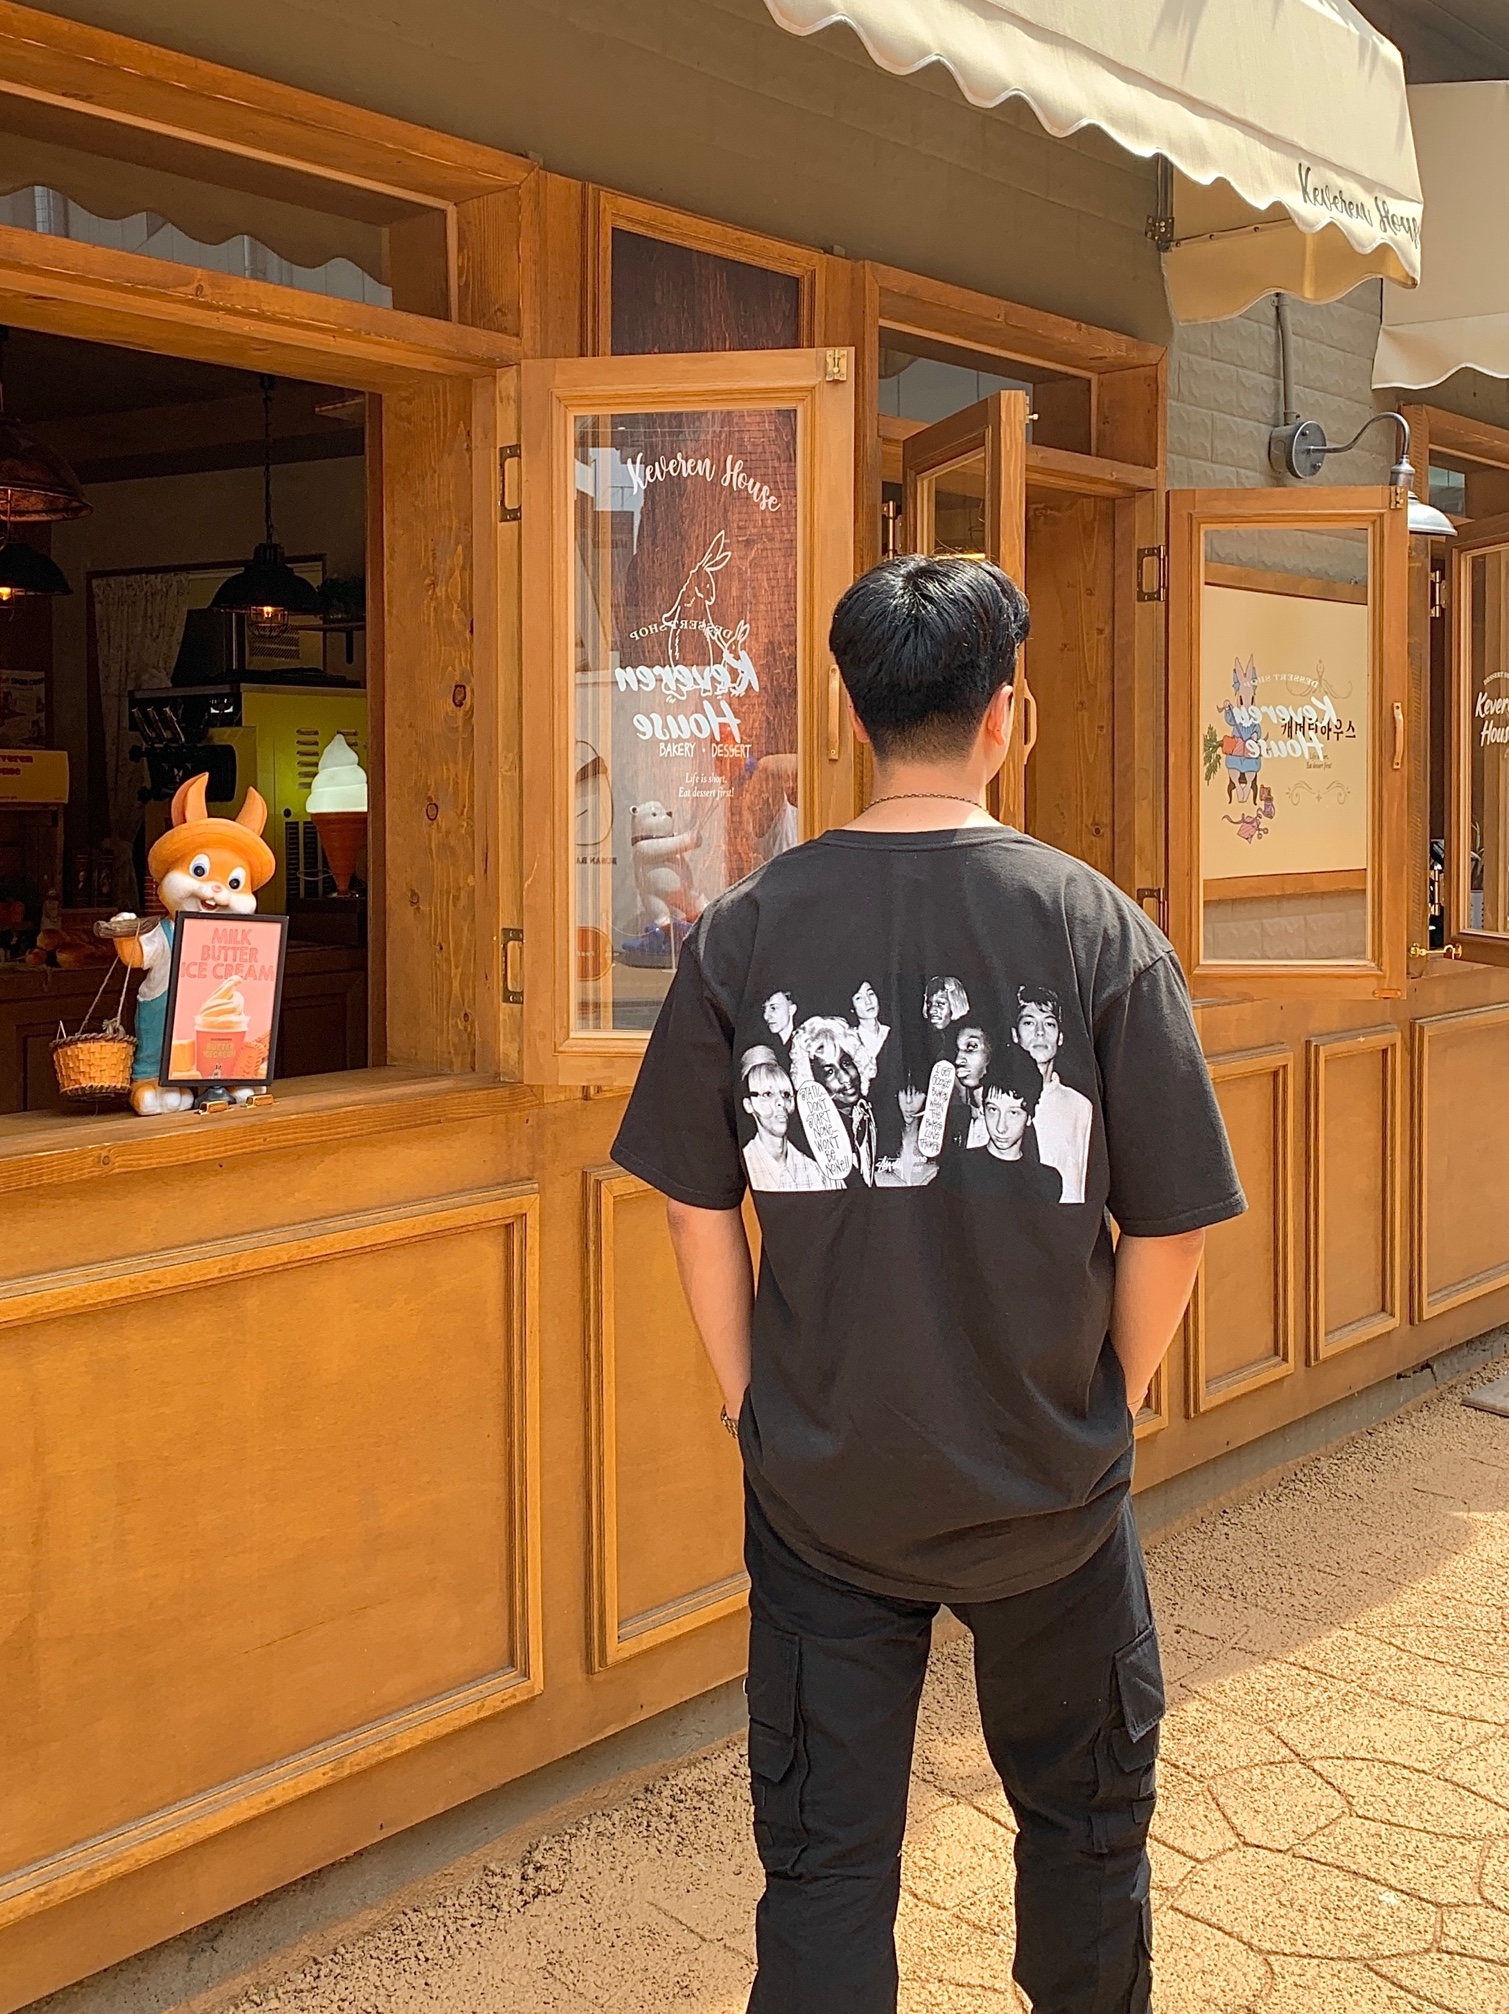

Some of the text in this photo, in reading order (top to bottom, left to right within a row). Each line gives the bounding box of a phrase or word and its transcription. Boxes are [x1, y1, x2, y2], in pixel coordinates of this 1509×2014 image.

[1298, 162, 1374, 228] Keveren
[626, 452, 782, 512] Keveren House
[659, 742, 752, 758] BAKERY DESSERT
[685, 772, 699, 786] Life
[700, 774, 707, 784] is
[678, 787, 691, 798] Eat
[693, 787, 716, 798] dessert
[211, 927, 252, 945] MILK
[200, 945, 258, 963] BUTTER
[180, 961, 275, 982] ICE CREAM
